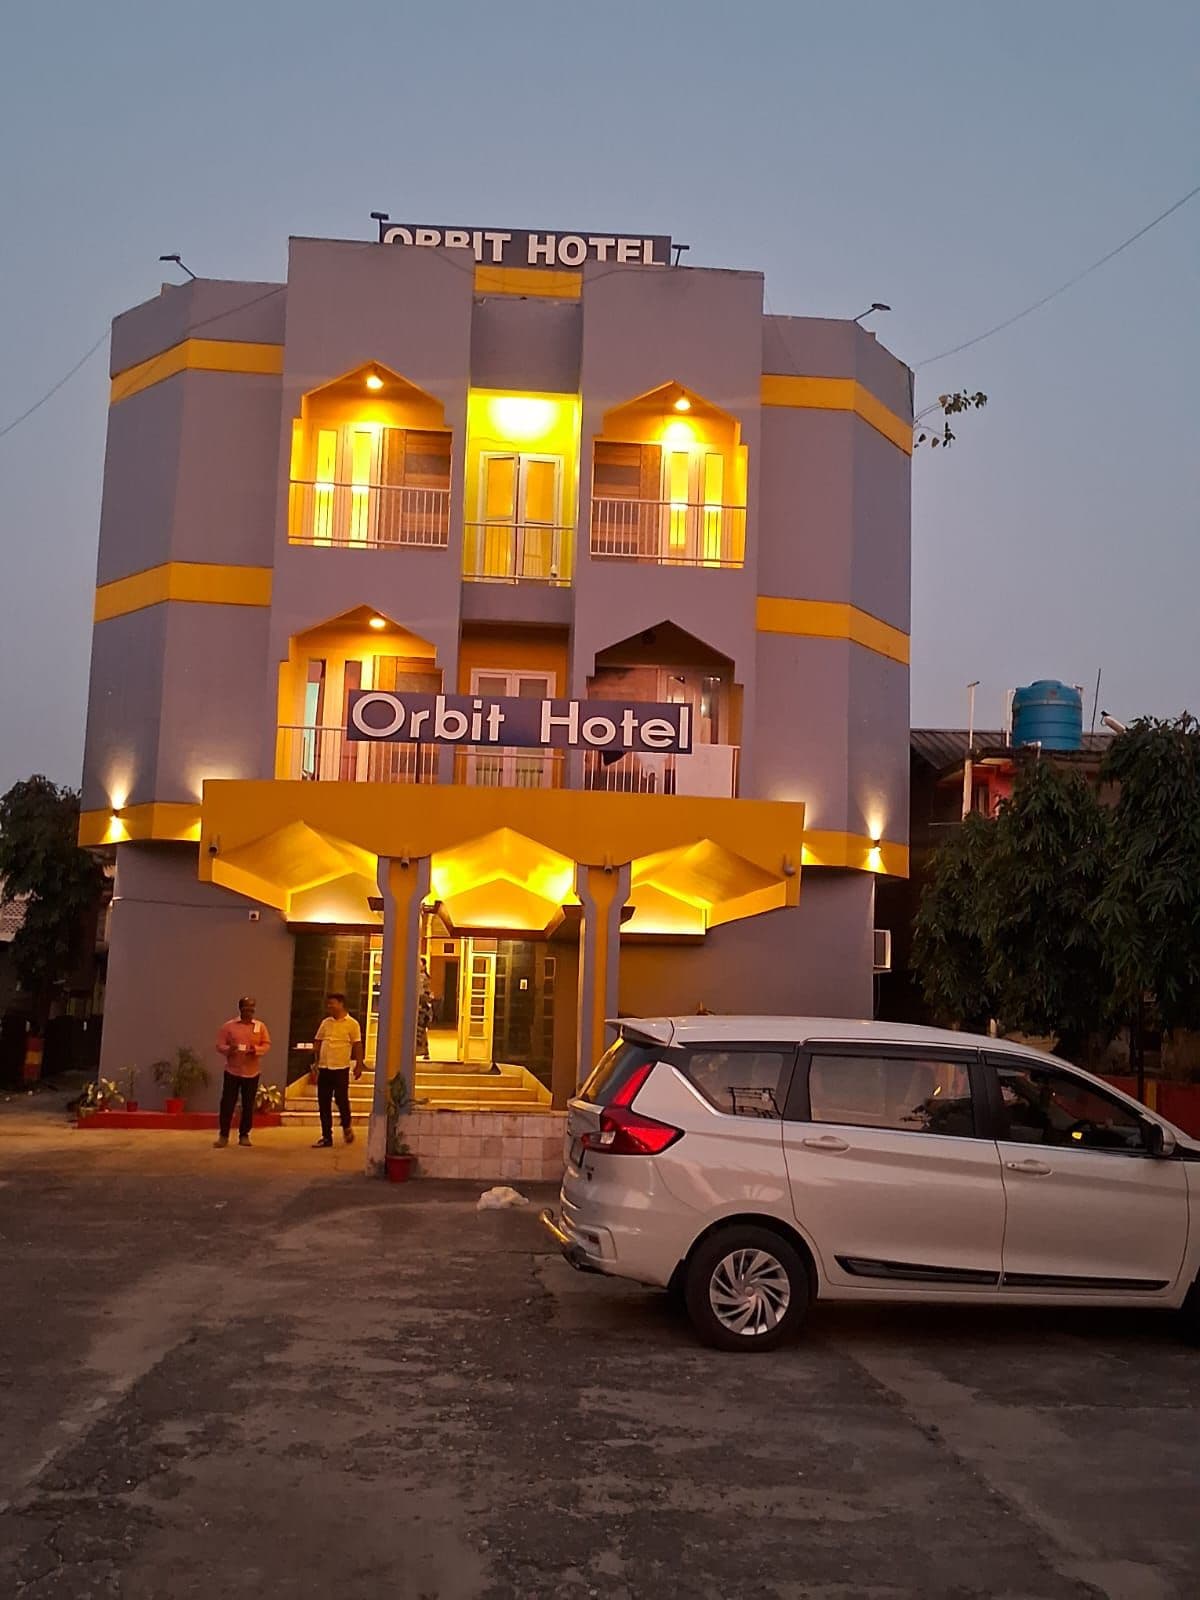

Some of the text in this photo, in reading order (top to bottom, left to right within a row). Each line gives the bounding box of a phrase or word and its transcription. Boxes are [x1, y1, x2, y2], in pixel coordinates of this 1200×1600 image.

[527, 233, 666, 266] HOTEL
[352, 692, 689, 749] Orbit Hotel
